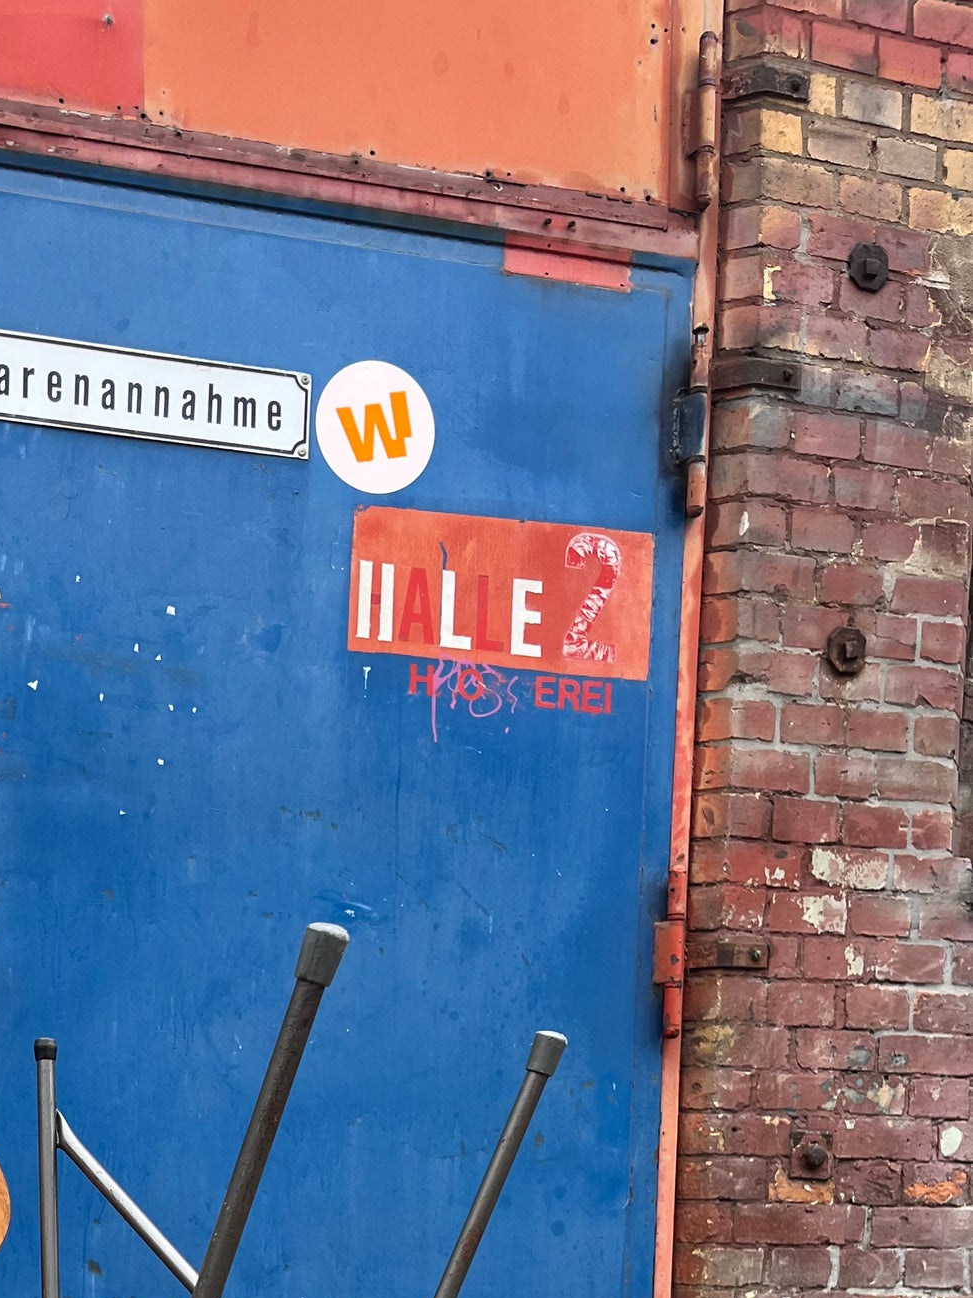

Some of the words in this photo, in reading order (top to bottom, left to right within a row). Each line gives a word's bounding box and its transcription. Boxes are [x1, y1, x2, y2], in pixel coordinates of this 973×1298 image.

[335, 390, 412, 463] W
[356, 560, 543, 657] HALLE
[562, 532, 622, 663] 2
